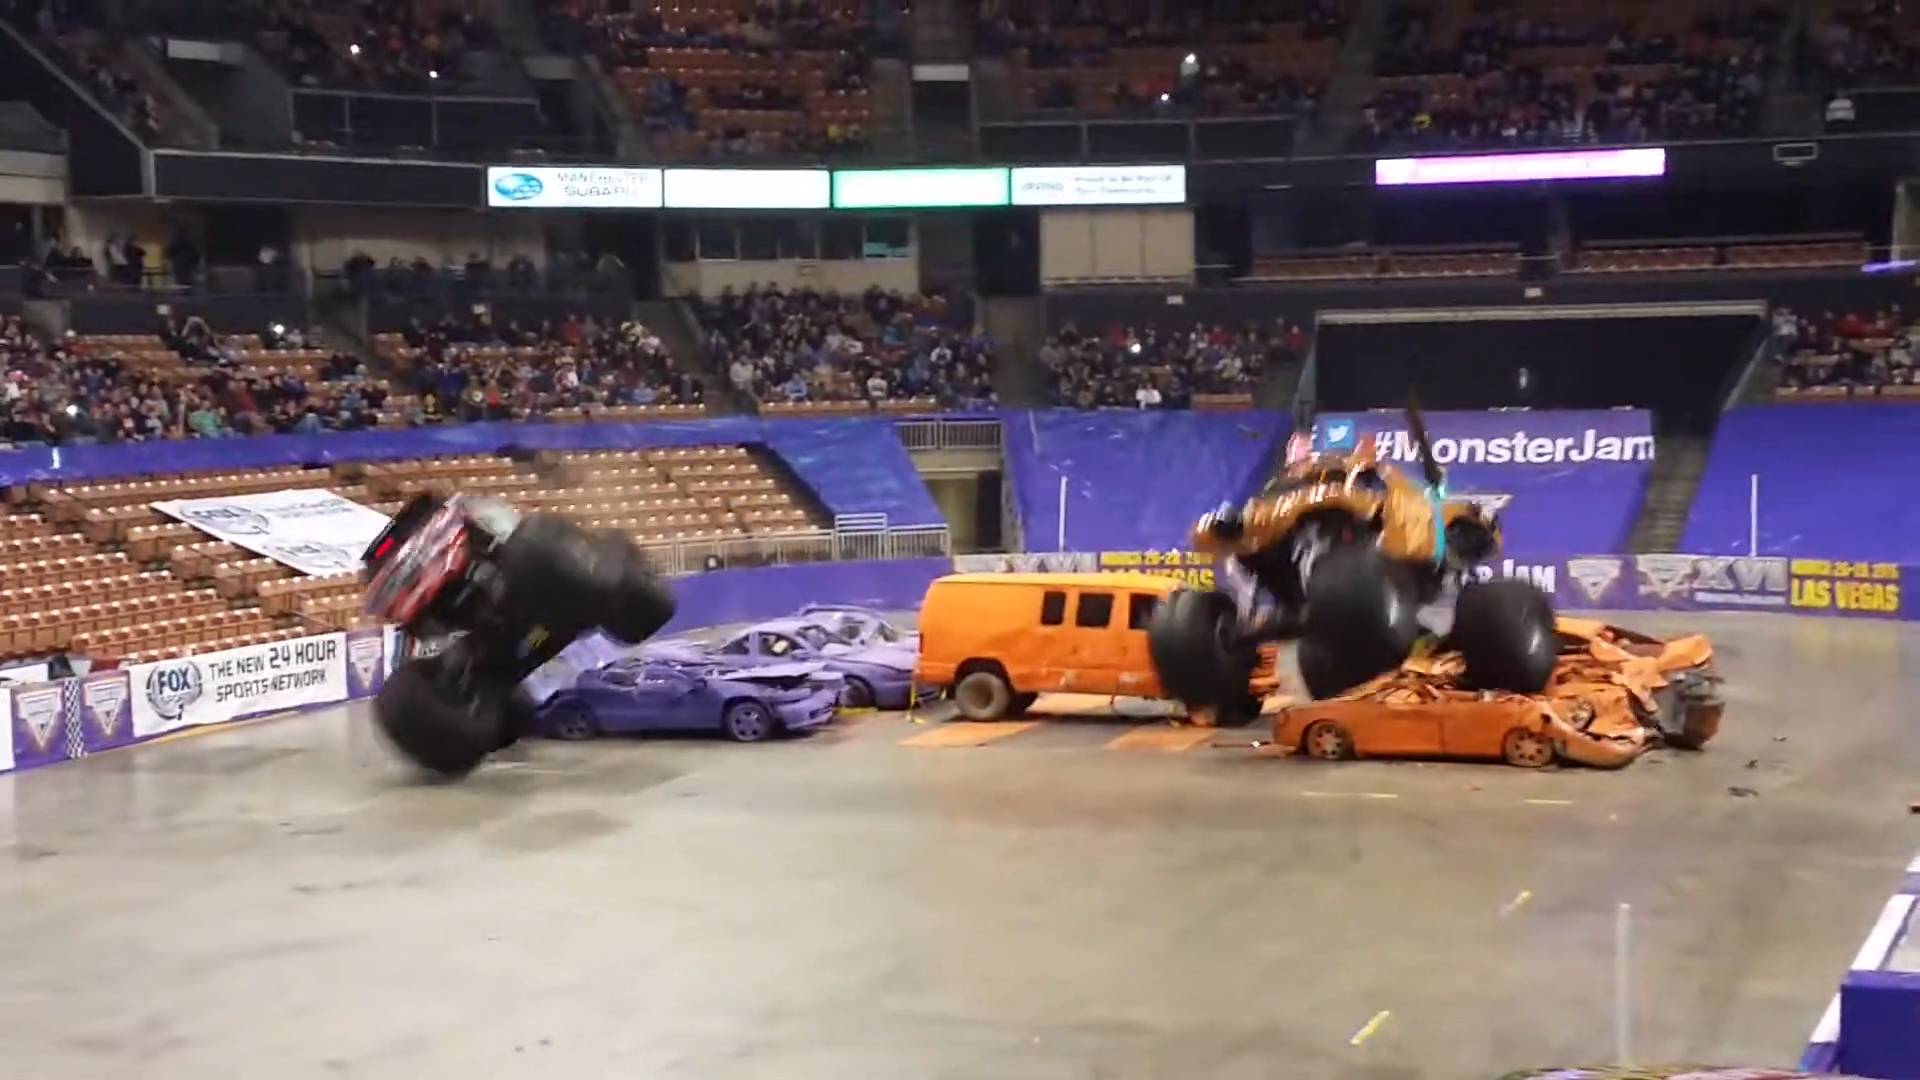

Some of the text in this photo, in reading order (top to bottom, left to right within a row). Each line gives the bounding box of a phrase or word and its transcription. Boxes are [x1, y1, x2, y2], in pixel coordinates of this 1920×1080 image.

[1791, 578, 1899, 611] LAS VEGAS
[209, 640, 336, 680] THE NEW 24 HOUR
[158, 666, 191, 695] FOX
[216, 669, 326, 702] SPORTS NETWORK
